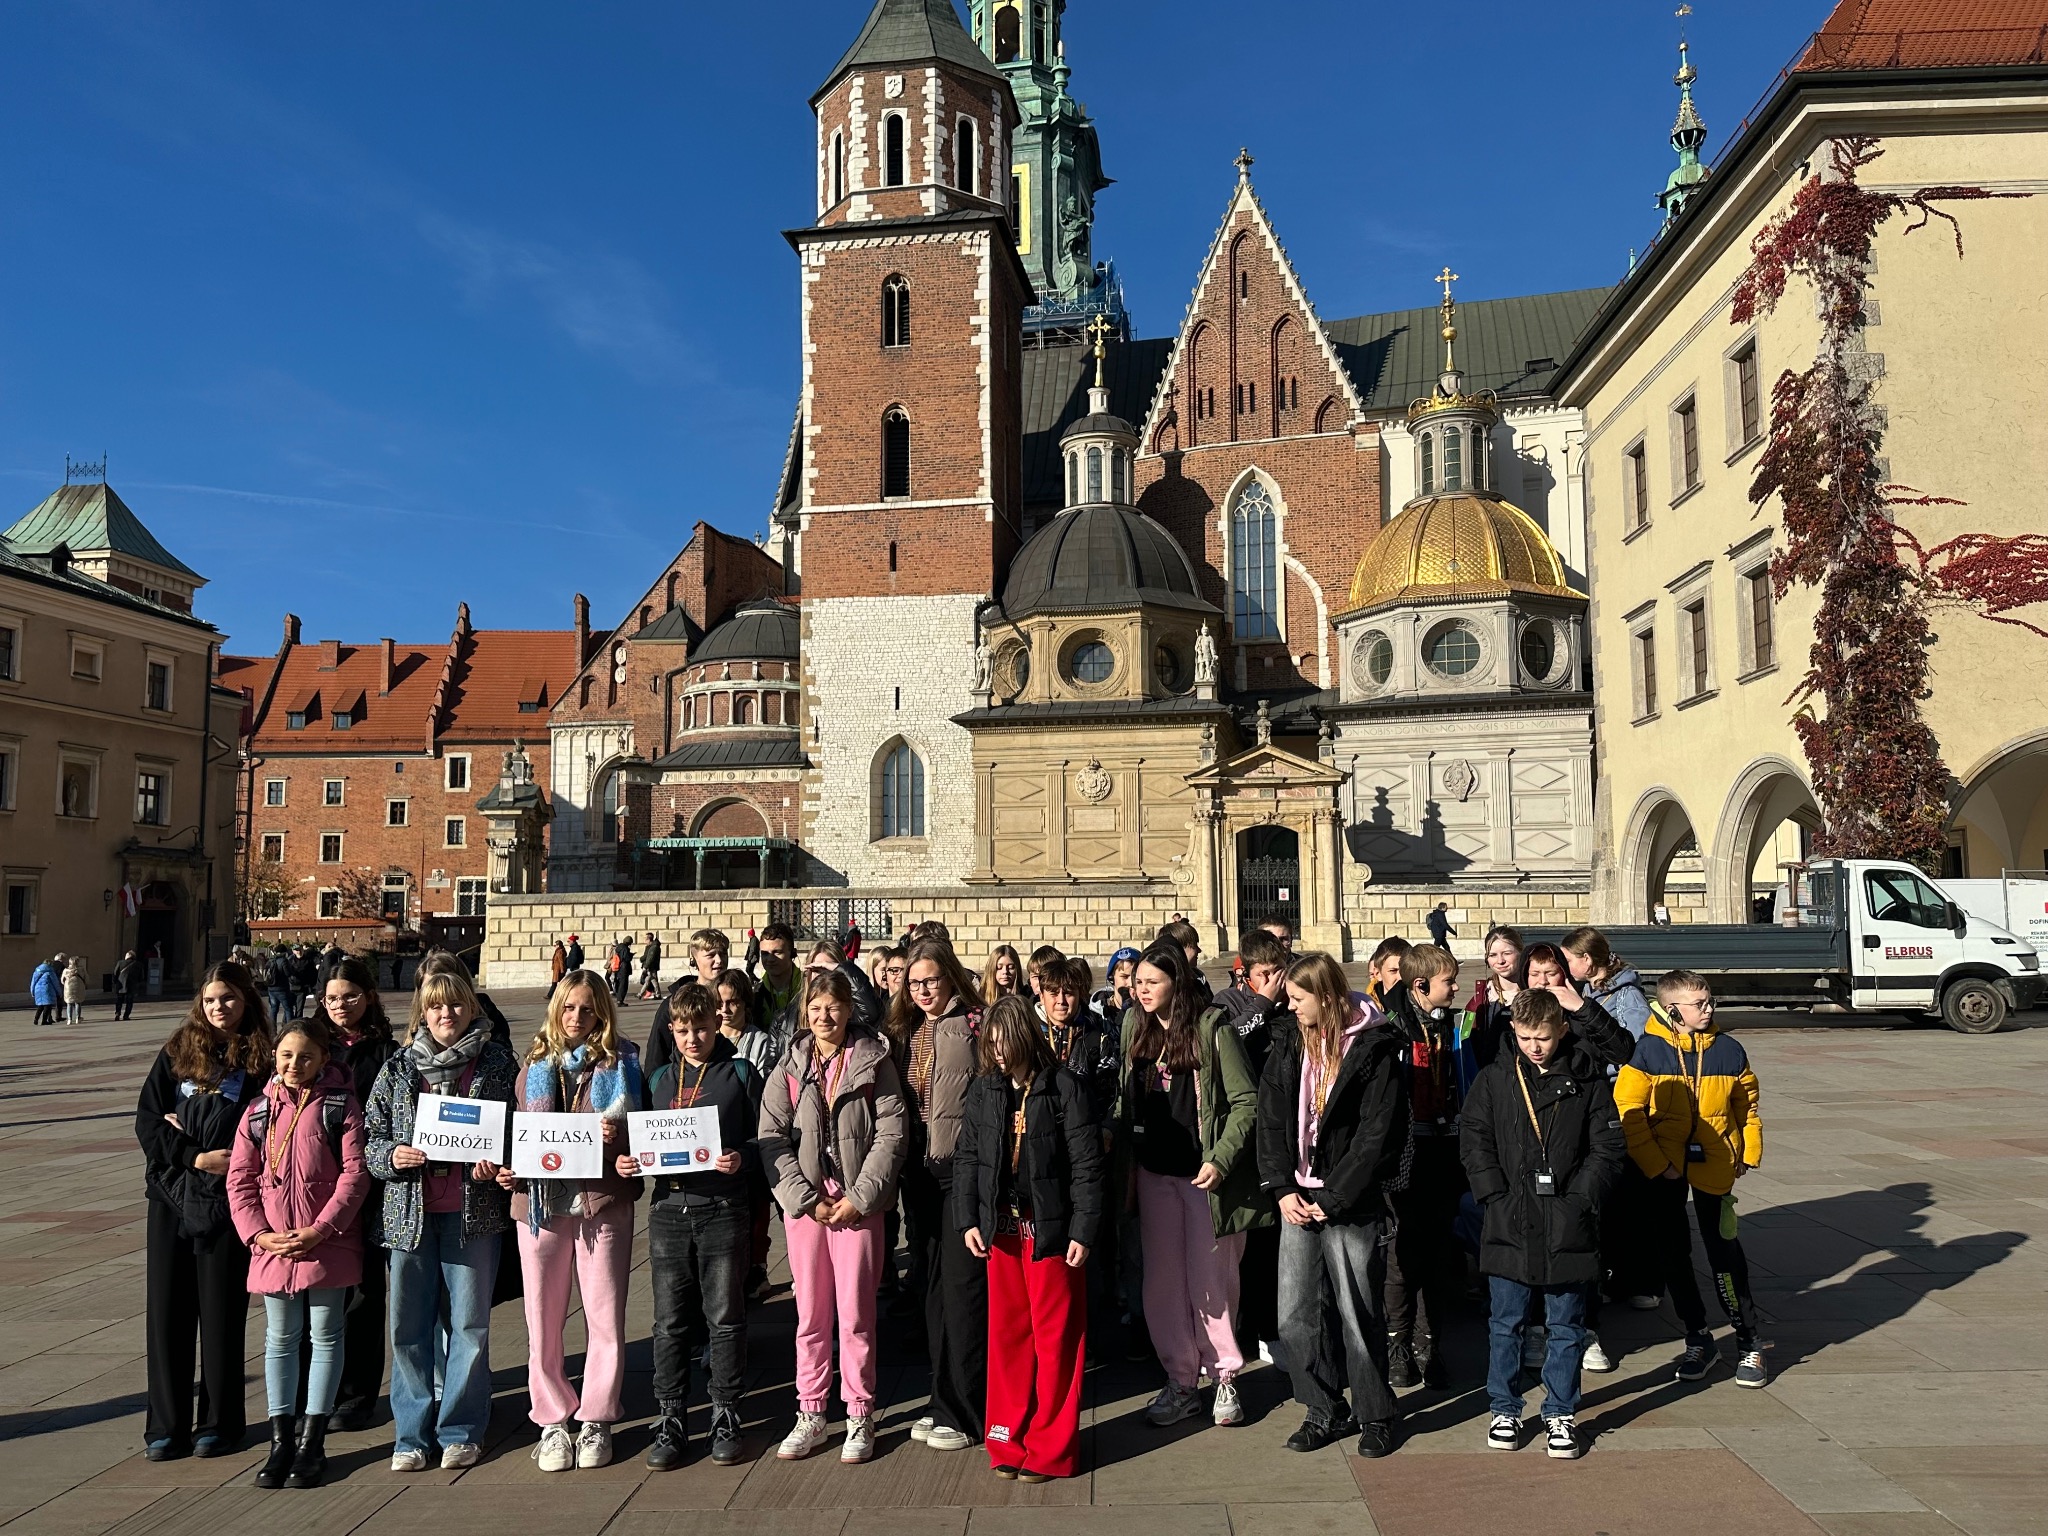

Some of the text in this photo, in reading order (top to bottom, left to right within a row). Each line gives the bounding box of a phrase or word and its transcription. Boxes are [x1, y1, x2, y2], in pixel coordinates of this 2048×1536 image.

[1885, 946, 1933, 956] ELBRUS
[645, 1115, 698, 1129] PODRÓŻE
[418, 1131, 493, 1150] PODRÓŻE
[518, 1129, 593, 1146] Z KLASĄ
[650, 1129, 698, 1141] Z KLASĄ
